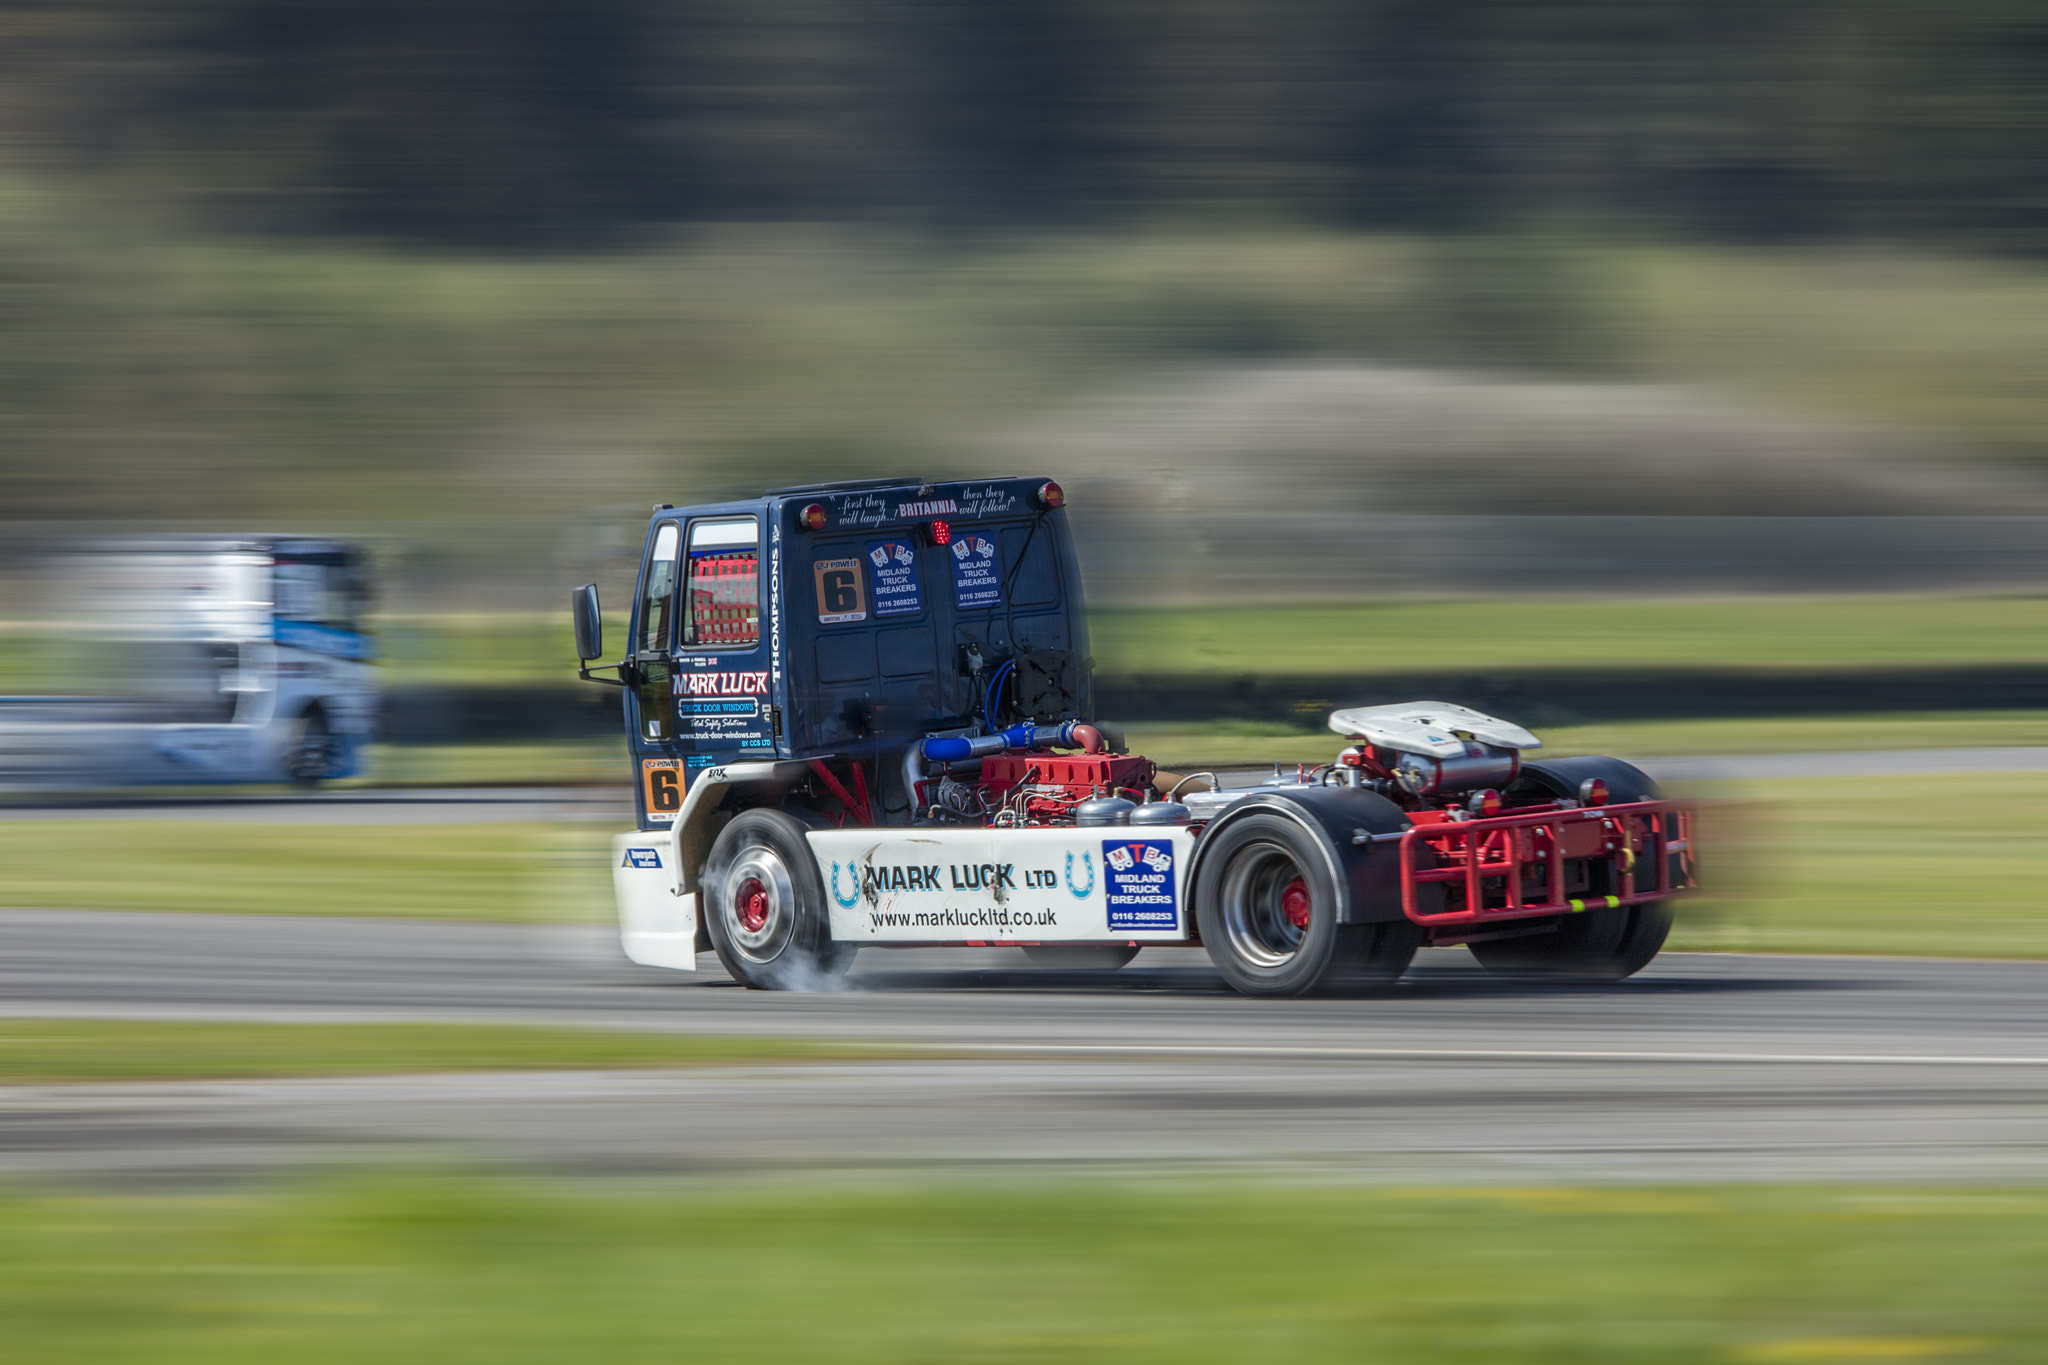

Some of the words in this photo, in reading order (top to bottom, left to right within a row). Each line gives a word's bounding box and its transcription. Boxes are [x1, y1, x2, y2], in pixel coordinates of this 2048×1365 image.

[963, 487, 982, 500] then
[985, 485, 1005, 501] they
[866, 494, 886, 512] they
[899, 499, 958, 517] BRITANNIA
[959, 502, 977, 515] will
[839, 513, 857, 525] will
[959, 560, 991, 570] MIDLAND
[877, 567, 911, 577] MIDLAND
[963, 569, 989, 578] TRUCK
[882, 576, 908, 585] TRUCK
[957, 577, 997, 587] BREAKERS
[823, 570, 858, 612] 6
[875, 584, 917, 595] BREAKERS
[877, 600, 892, 608] 0116
[771, 547, 781, 683] THOMPSONS
[672, 672, 720, 696] MARK
[720, 671, 769, 695] LUCK
[682, 704, 702, 713] TRUCK
[703, 703, 720, 712] DOOR
[722, 703, 754, 712] WINDOWS
[680, 731, 761, 740] www.truck-door-windows.com
[651, 770, 680, 811] 6
[866, 864, 942, 892] MARK
[950, 863, 1017, 891] LUCK
[1025, 870, 1058, 889] LTD
[1115, 874, 1166, 883] MIDLAND
[1121, 885, 1161, 893] TRUCK
[1111, 895, 1173, 904] BREAKERS
[871, 907, 1057, 927] www.markluckltd.co.uk
[1112, 912, 1134, 920] 0116
